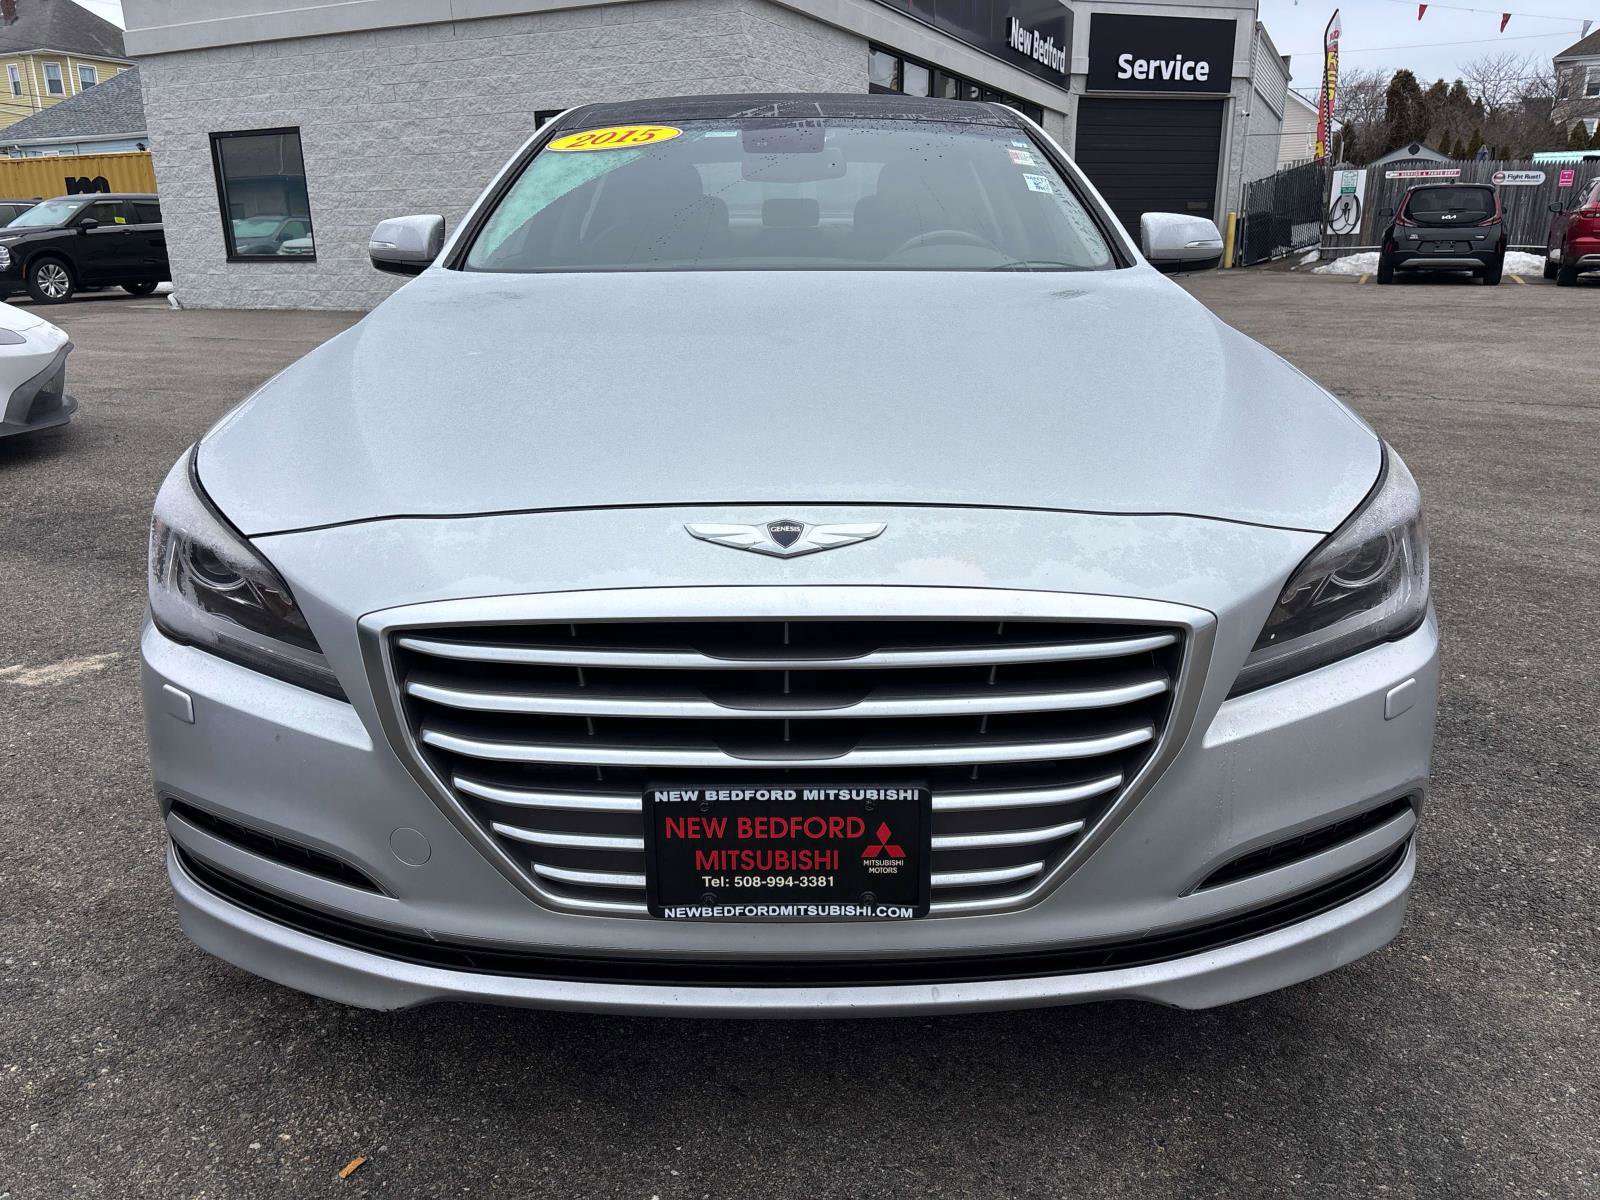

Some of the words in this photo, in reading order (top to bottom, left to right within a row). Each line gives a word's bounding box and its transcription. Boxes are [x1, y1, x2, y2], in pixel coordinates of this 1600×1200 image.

[1010, 16, 1032, 55] New
[1033, 30, 1066, 73] Bedford
[1117, 53, 1210, 82] Service
[566, 128, 662, 148] 2015
[654, 791, 698, 802] NEW
[705, 790, 797, 801] BEDFORD
[803, 789, 919, 801] MITSUBISHI
[665, 816, 728, 839] NEW
[737, 816, 866, 839] BEDFORD
[695, 849, 839, 871] MITSUBISHI
[863, 859, 904, 867] MITSUBISHI
[702, 875, 730, 887] Tel:
[733, 875, 835, 888] 508-994-3381
[664, 905, 913, 919] NEWBEDFORDMITSUBISHI.COM
